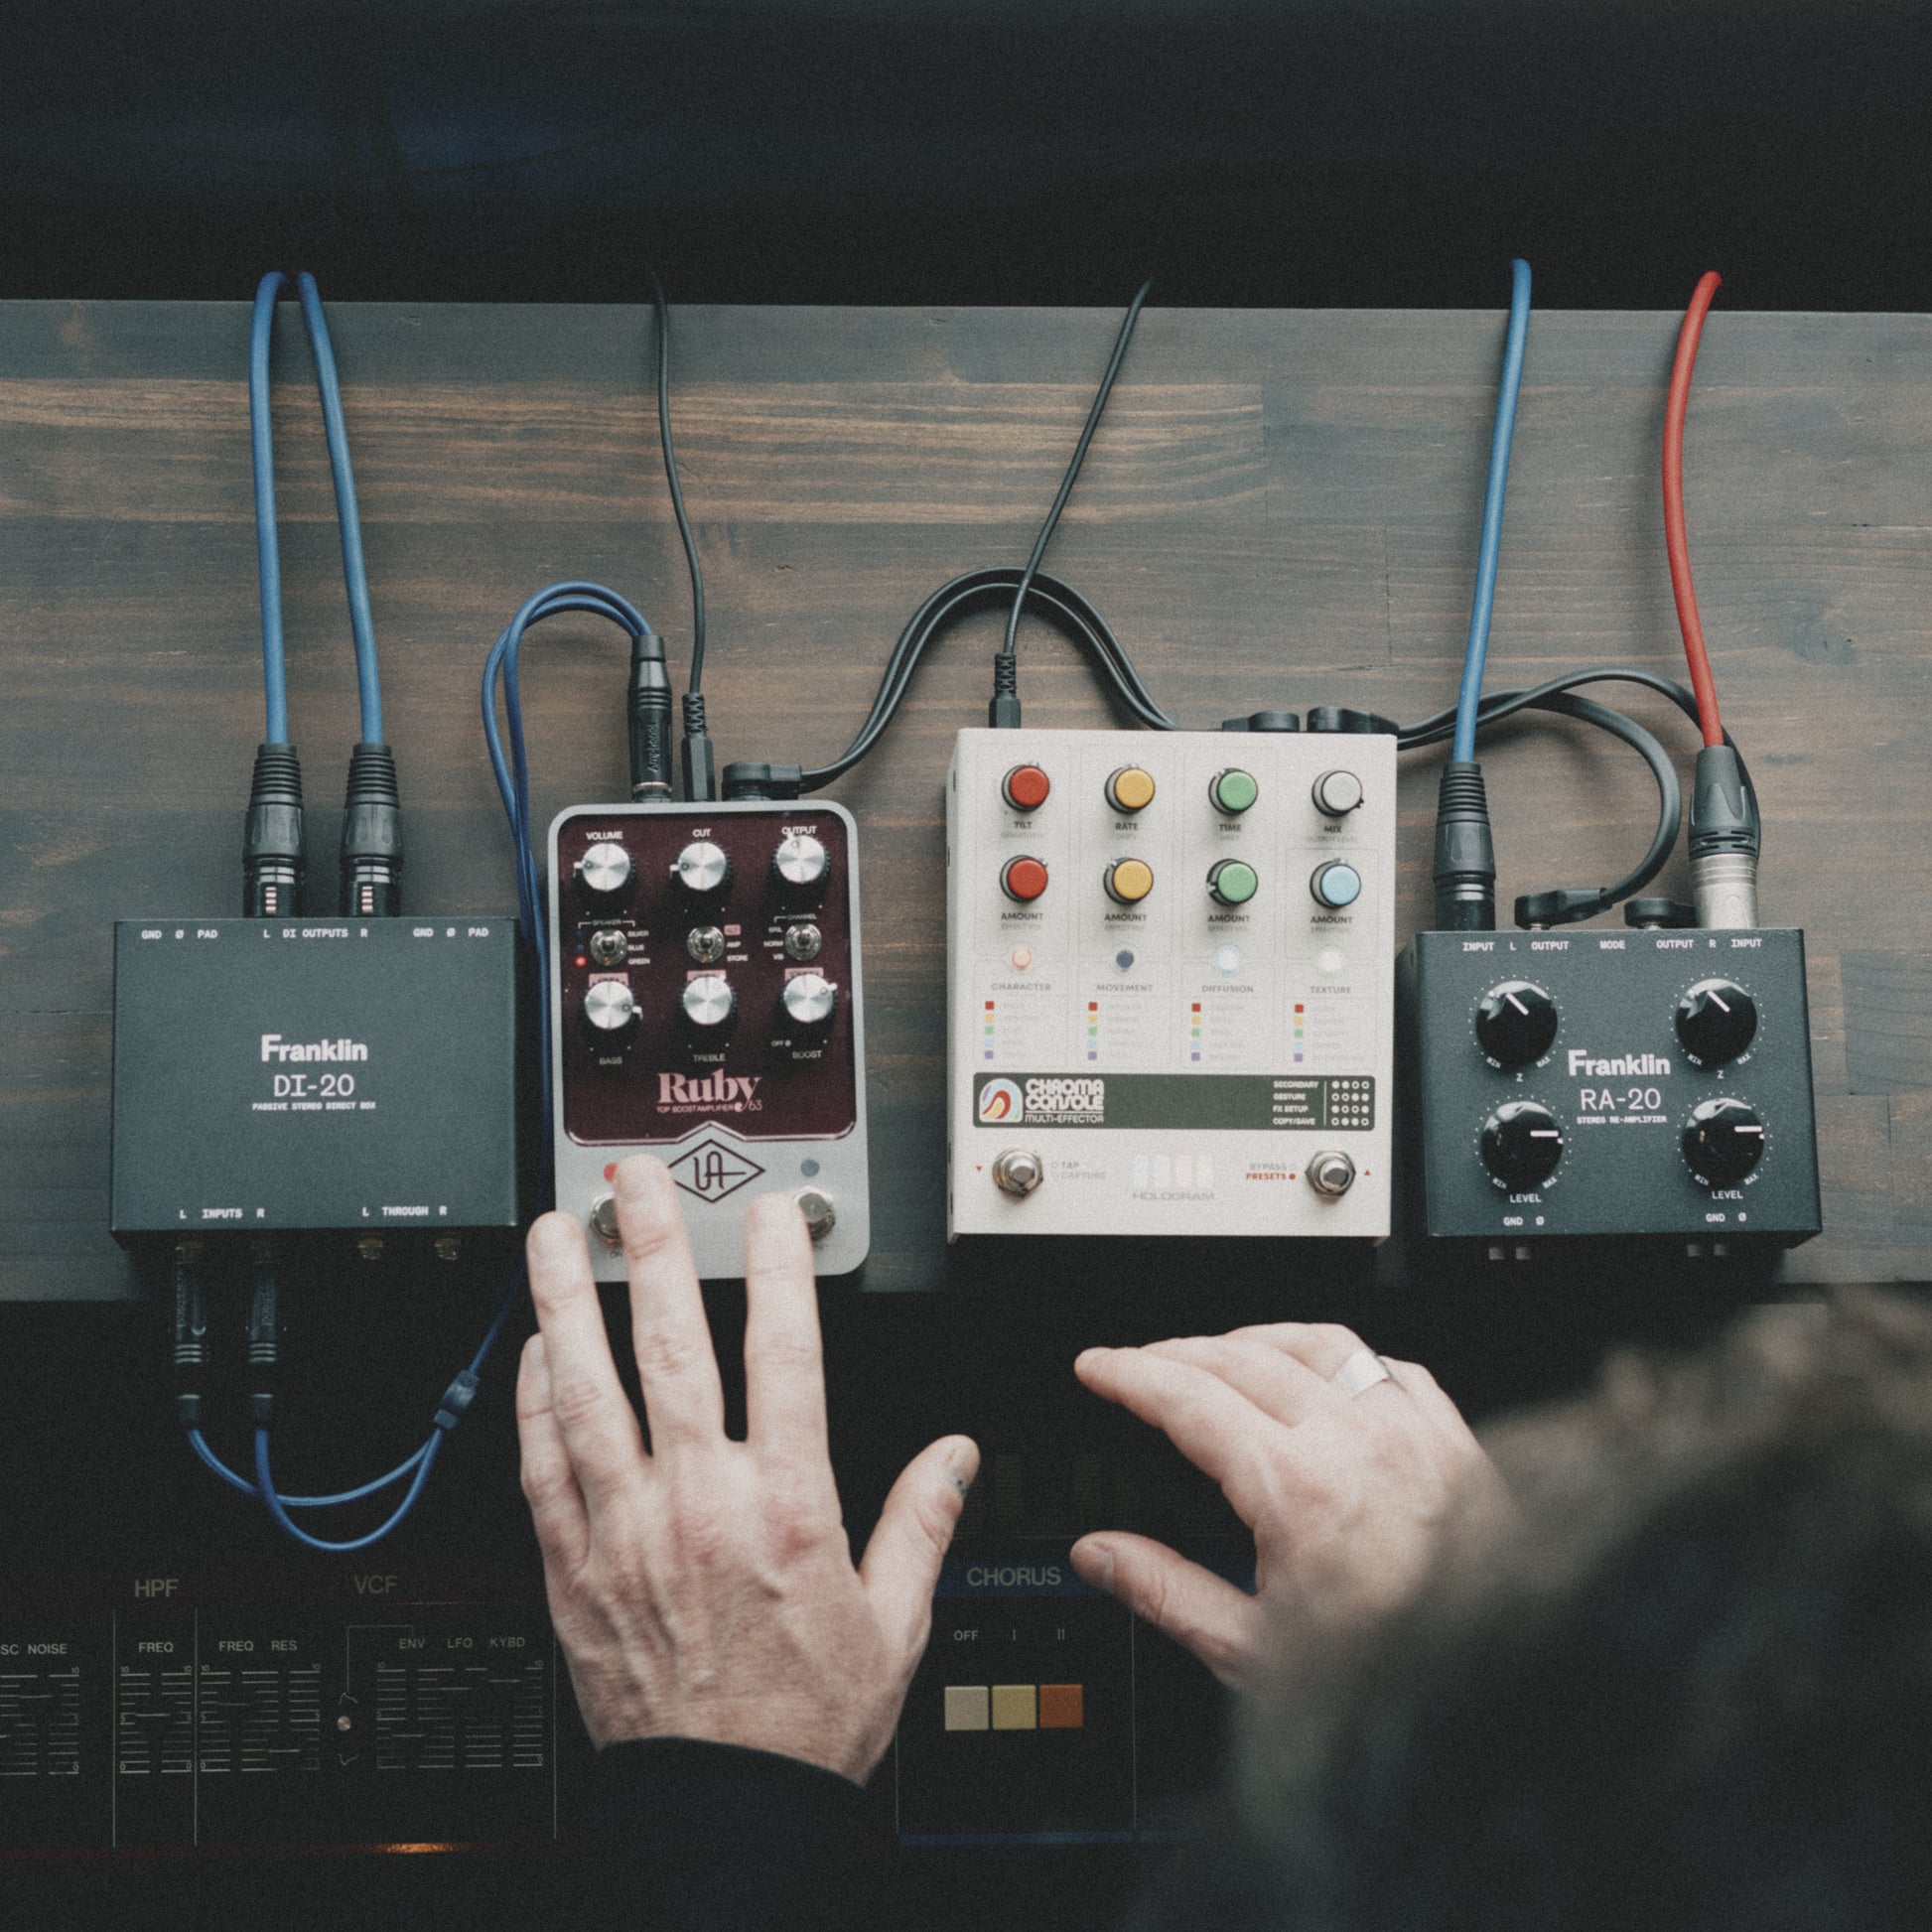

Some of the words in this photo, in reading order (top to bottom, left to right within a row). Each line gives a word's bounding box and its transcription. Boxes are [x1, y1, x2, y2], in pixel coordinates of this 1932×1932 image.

[781, 825, 817, 835] OUTPUT
[1014, 821, 1033, 830] TILT
[1115, 822, 1139, 831] RATE
[1218, 823, 1241, 832] TIME
[1323, 825, 1342, 834] MIX
[586, 830, 623, 841] VOLUME
[692, 828, 712, 838] CUT
[1311, 915, 1352, 924] AMOUNT
[141, 929, 162, 940] GND
[197, 929, 218, 939] PAD
[263, 929, 270, 938] L
[282, 928, 297, 938] DI
[302, 927, 348, 938] OUTPUTS
[360, 927, 368, 937] R
[413, 927, 434, 937] GND
[468, 927, 489, 937] PAD
[1462, 941, 1494, 952] INPUT
[1509, 942, 1517, 951] L
[1531, 940, 1569, 950] OUTPUT
[1599, 940, 1625, 950] MODE
[1656, 939, 1694, 949] OUTPUT
[1709, 939, 1717, 948] R
[1730, 938, 1762, 948] INPUT
[991, 982, 1051, 991] CHARACTER
[1096, 983, 1153, 992] MOVEMENT
[261, 1034, 368, 1062] Franklin
[693, 1053, 726, 1062] TREBLE
[791, 1050, 822, 1059] BOOST
[1688, 1053, 1703, 1065] MIN
[1736, 1052, 1751, 1065] MAX
[599, 1056, 622, 1065] BASS
[1486, 1056, 1502, 1068] MIN
[1536, 1055, 1551, 1068] MAX
[1568, 1048, 1671, 1076] Franklin
[1516, 1072, 1524, 1082] Z
[1717, 1069, 1725, 1079] Z
[273, 1073, 354, 1097] DI-20
[657, 1068, 761, 1112] Ruby
[1025, 1077, 1105, 1095] CHROMA
[1273, 1092, 1307, 1101] GESTURE
[1580, 1087, 1661, 1111] RA-20
[252, 1102, 288, 1111] PASSIVE
[359, 1101, 376, 1110] BOX
[1025, 1094, 1104, 1111] CONSOLE
[1025, 1114, 1104, 1123] MULTI-EFFECTOR
[1272, 1117, 1315, 1126] COPY/SAVE
[1577, 1116, 1606, 1125] STEREO
[1609, 1115, 1667, 1124] RE-AMPLIFIER
[1492, 1177, 1507, 1189] MIN
[1542, 1176, 1558, 1189] MAX
[1694, 1173, 1710, 1186] MIN
[1744, 1173, 1759, 1185] MAX
[1132, 1192, 1215, 1201] HOLOGRAM
[1509, 1193, 1542, 1203] LEVEL
[1712, 1189, 1743, 1199] LEVEL
[180, 1209, 187, 1219] L
[202, 1208, 243, 1219] INPUTS
[256, 1208, 265, 1218] R
[362, 1207, 369, 1216] L
[381, 1206, 429, 1216] THROUGH
[439, 1205, 447, 1216] R
[1503, 1216, 1523, 1226] GND
[1706, 1212, 1725, 1222] GND
[967, 1567, 1061, 1587] CHORUS
[134, 1578, 179, 1597] HPF
[353, 1575, 398, 1594] VCF
[953, 1630, 979, 1641] OFF
[138, 1641, 174, 1653] FREQ
[218, 1640, 254, 1652] FREQ
[271, 1640, 298, 1651] RES
[399, 1639, 425, 1649] ENV
[447, 1637, 473, 1648] LFO
[489, 1636, 526, 1648] KYBD
[28, 1643, 68, 1655] NOISE
